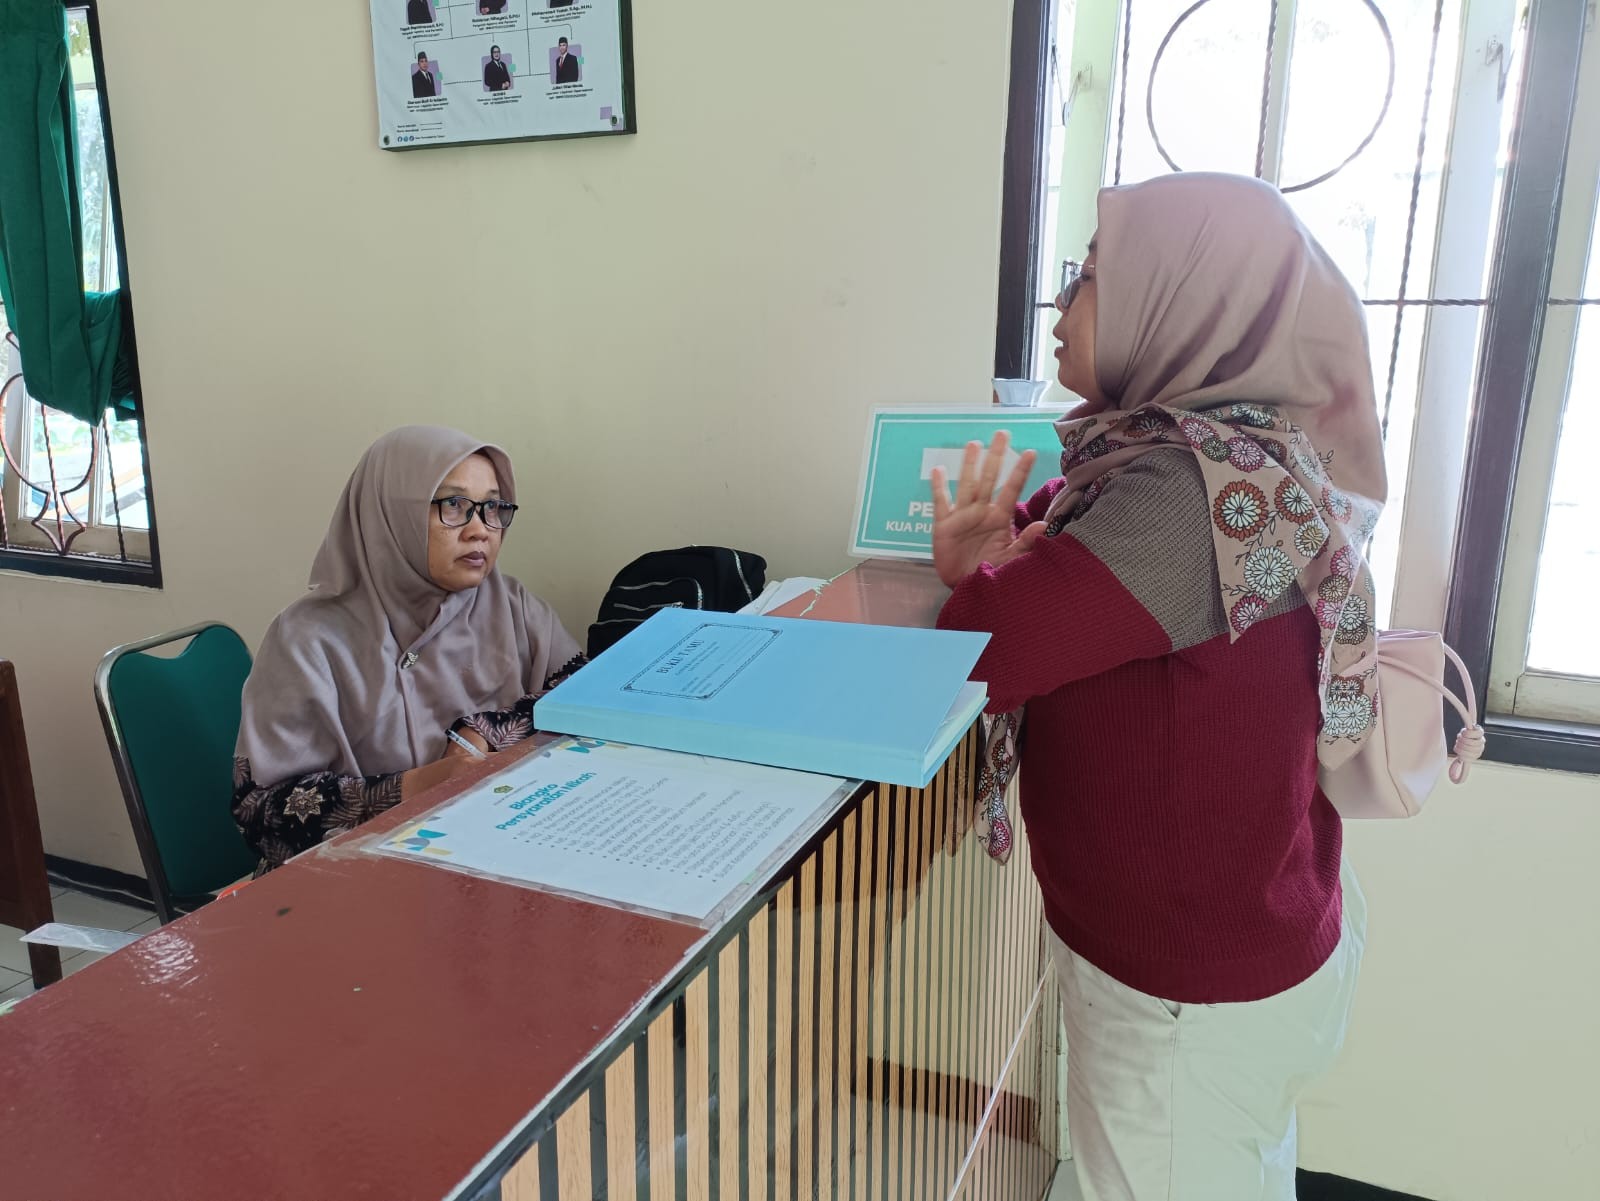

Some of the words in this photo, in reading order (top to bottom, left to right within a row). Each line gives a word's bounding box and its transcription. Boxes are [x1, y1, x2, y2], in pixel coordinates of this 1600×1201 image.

[886, 521, 912, 532] KUA
[656, 656, 684, 674] BUKU
[678, 640, 705, 656] TAMU
[495, 788, 570, 831] Persyaratan
[560, 772, 598, 792] Nikah
[508, 783, 559, 810] Blangko
